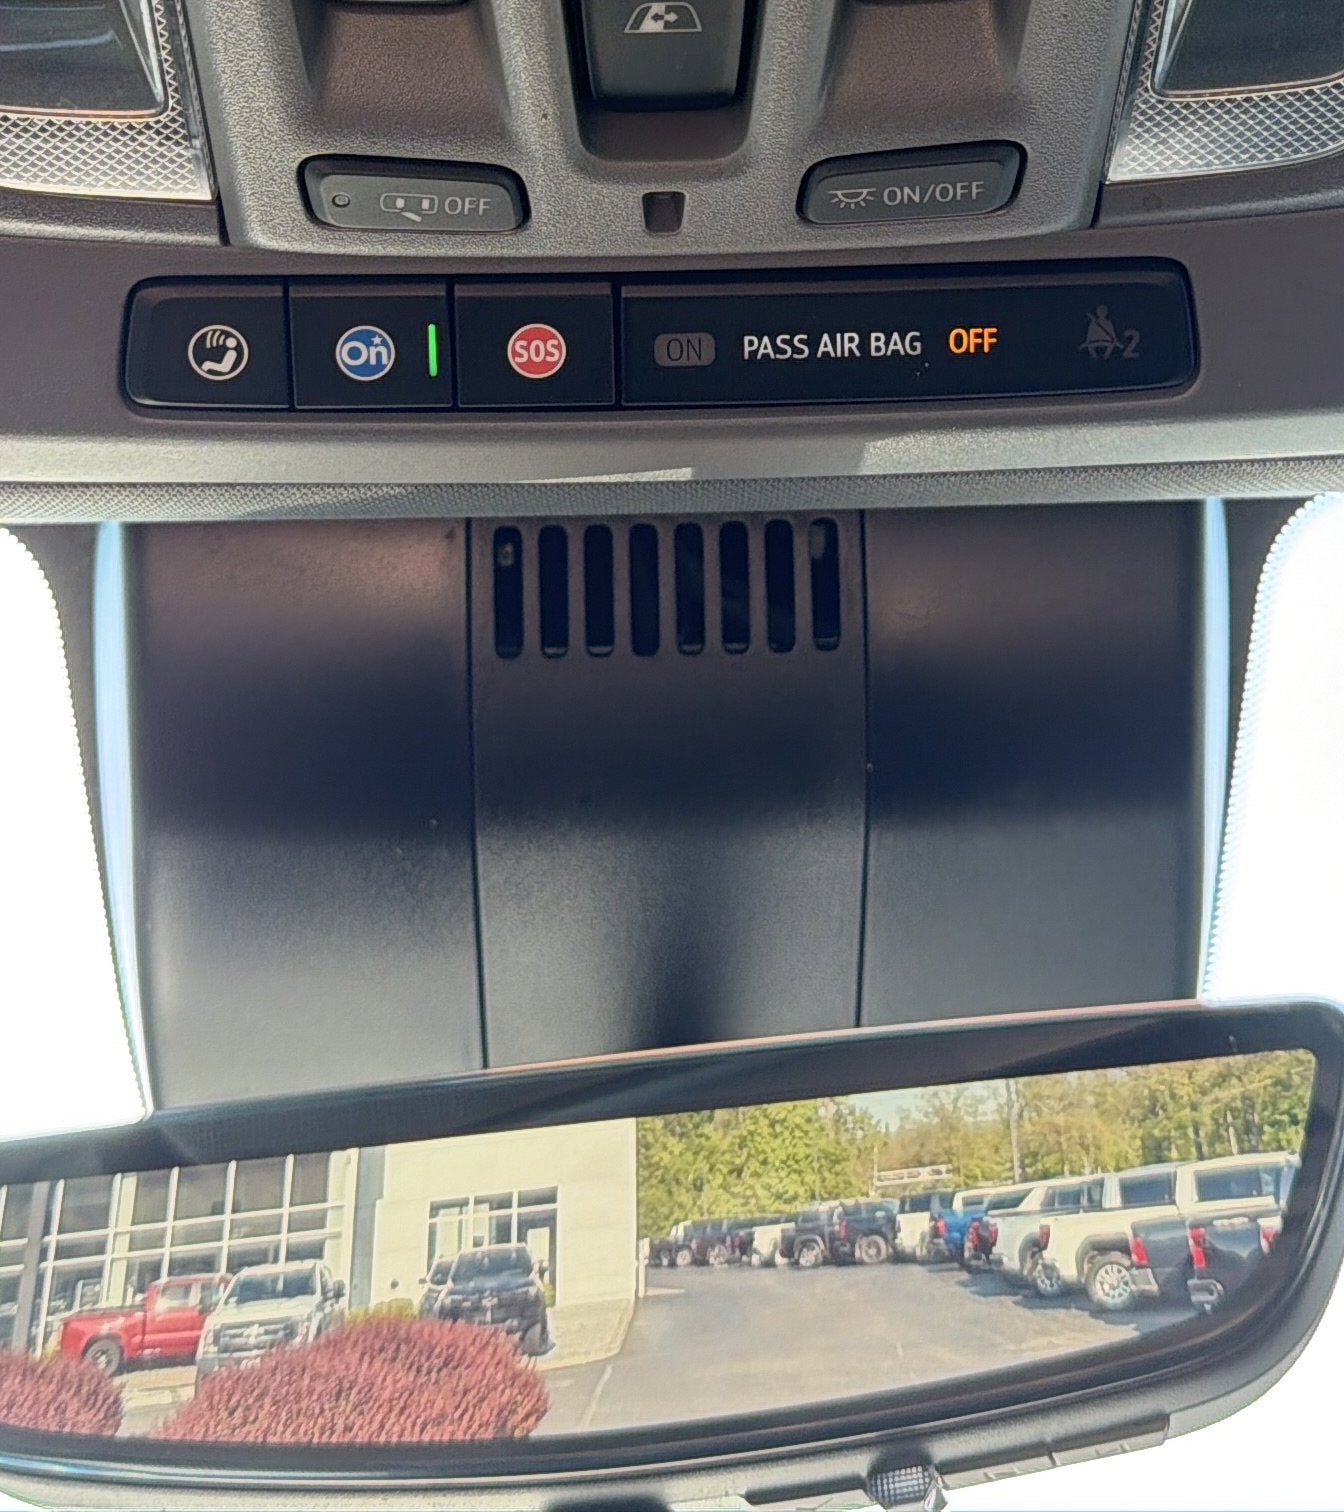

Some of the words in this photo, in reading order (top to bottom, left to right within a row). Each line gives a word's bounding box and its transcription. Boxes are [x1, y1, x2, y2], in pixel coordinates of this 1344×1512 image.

[883, 180, 985, 206] ON/OFF
[444, 196, 492, 216] OFF
[342, 341, 389, 366] On
[514, 339, 561, 364] SOS
[666, 339, 703, 363] ON
[744, 335, 809, 361] PASS
[817, 333, 861, 359] AIR
[870, 331, 922, 357] BAG
[948, 327, 999, 354] OFF
